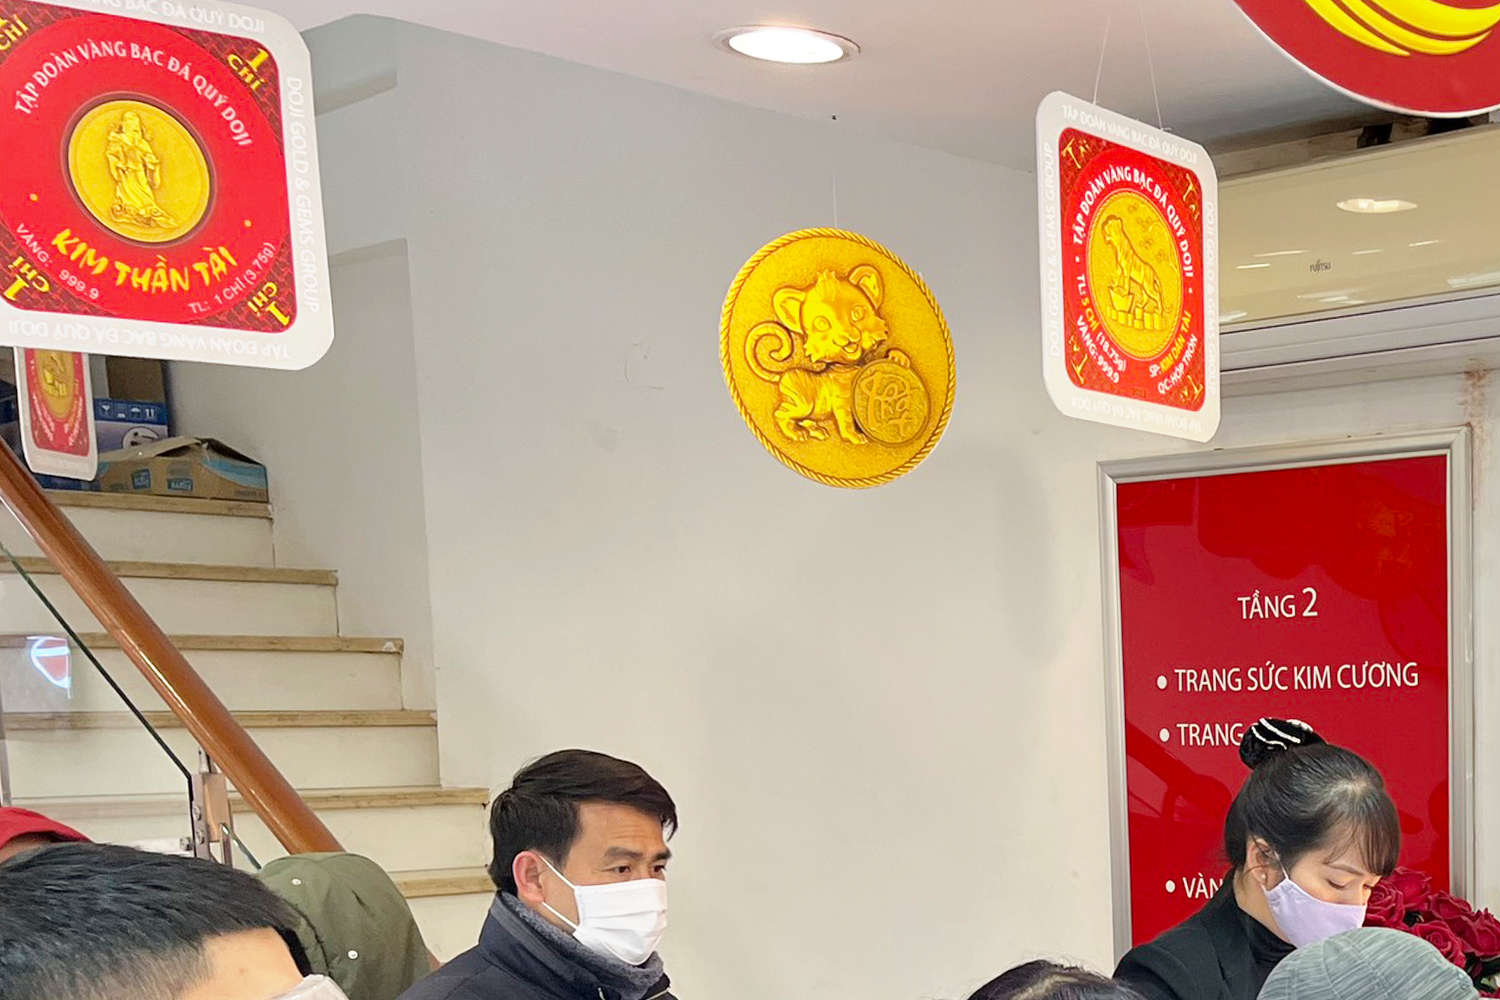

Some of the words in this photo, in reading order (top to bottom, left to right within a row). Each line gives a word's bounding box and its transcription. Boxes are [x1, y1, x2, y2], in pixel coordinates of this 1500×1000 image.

[245, 48, 269, 73] 1
[14, 82, 39, 114] TẬP
[32, 49, 79, 87] ĐOÀN
[76, 38, 126, 60] VÀNG
[130, 42, 164, 66] BẠC
[167, 56, 192, 81] ĐÁ
[192, 74, 228, 107] QUÝ
[221, 107, 252, 145] DOJI
[287, 77, 304, 118] DOJI
[290, 121, 309, 174] GOLD
[296, 194, 315, 245] GEMS
[1073, 213, 1087, 245] TẬP
[1080, 176, 1106, 215] ĐOÀN
[1103, 164, 1131, 187] VÀNG
[1133, 168, 1154, 192] BẠC
[1153, 185, 1169, 209] ĐÁ
[1166, 205, 1186, 238] QUÝ
[1180, 239, 1194, 277] DOJI
[51, 228, 109, 275] KIM
[114, 254, 190, 294] THẦN
[192, 246, 238, 287] TÀI
[299, 251, 320, 312] GROUP
[1237, 589, 1296, 619] TẦNG
[1302, 587, 1318, 617] 2
[1174, 668, 1242, 692] TRANG
[1247, 660, 1288, 691] SỨC
[1294, 665, 1332, 690] KIM
[1337, 660, 1419, 689] CƯƠNG
[1177, 723, 1244, 746] TRANG
[1183, 873, 1223, 899] VÀN
